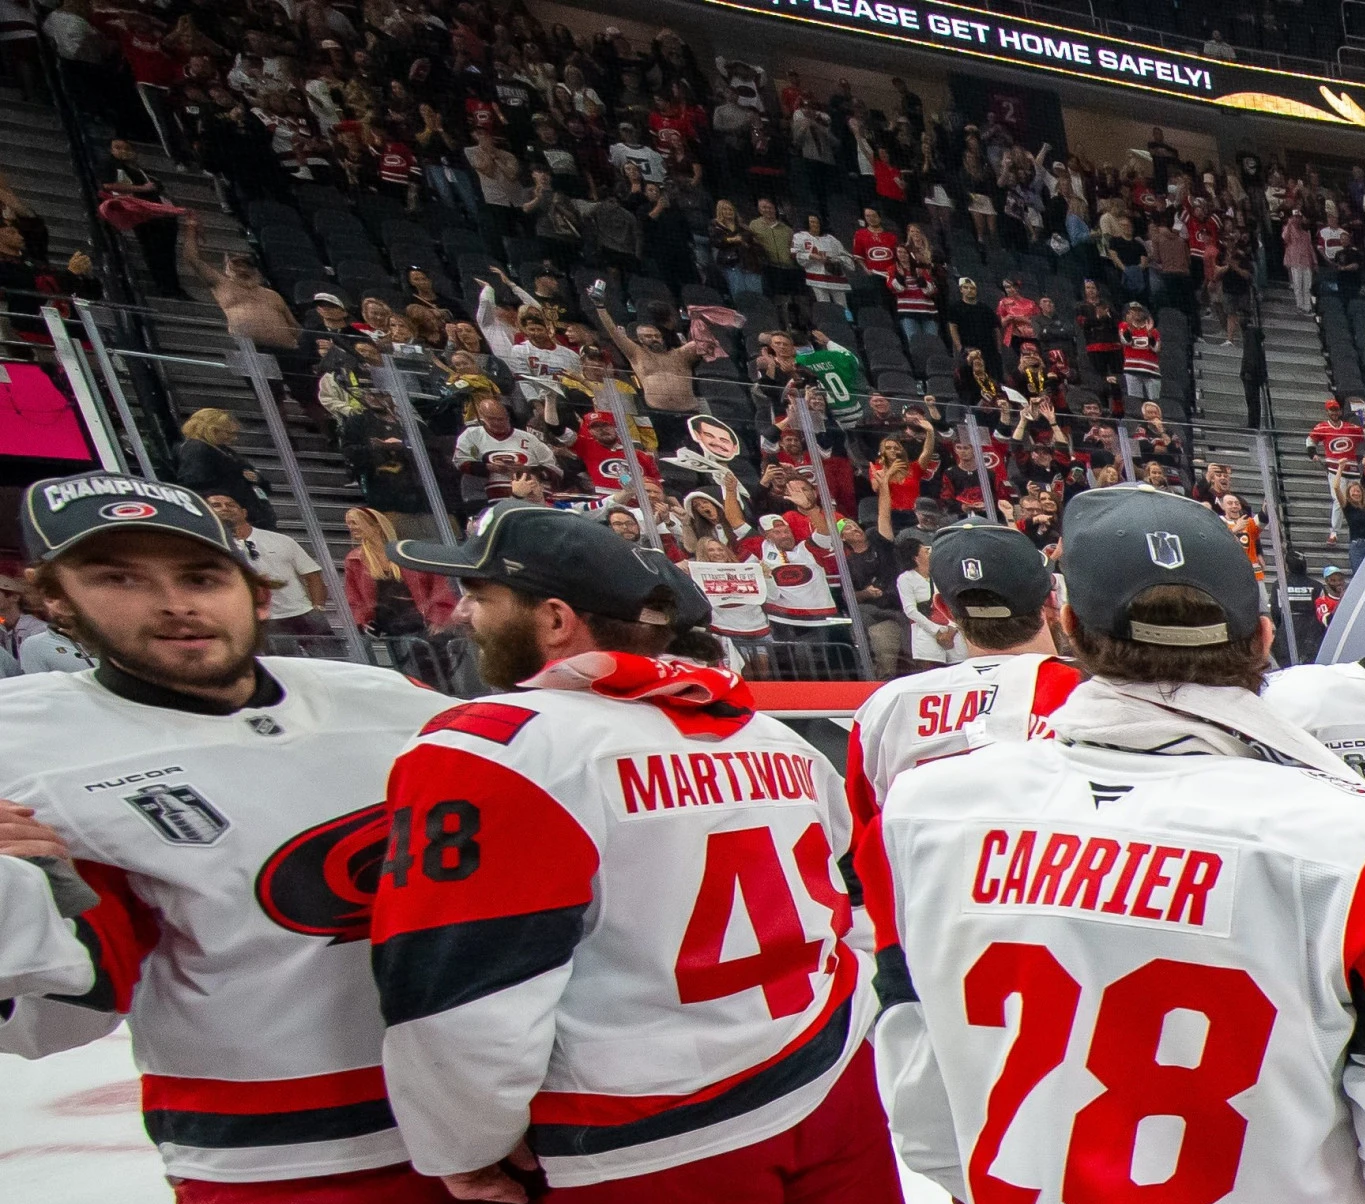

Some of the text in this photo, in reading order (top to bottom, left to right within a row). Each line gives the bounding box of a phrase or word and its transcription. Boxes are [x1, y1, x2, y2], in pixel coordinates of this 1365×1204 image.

[802, 0, 1212, 90] LEASE GET HOME SAFELY!
[43, 477, 202, 518] CHAMPIONS
[1288, 586, 1314, 594] BEST
[84, 765, 184, 792] NUCOR
[379, 799, 481, 888] 48
[971, 829, 1224, 927] CARRIER
